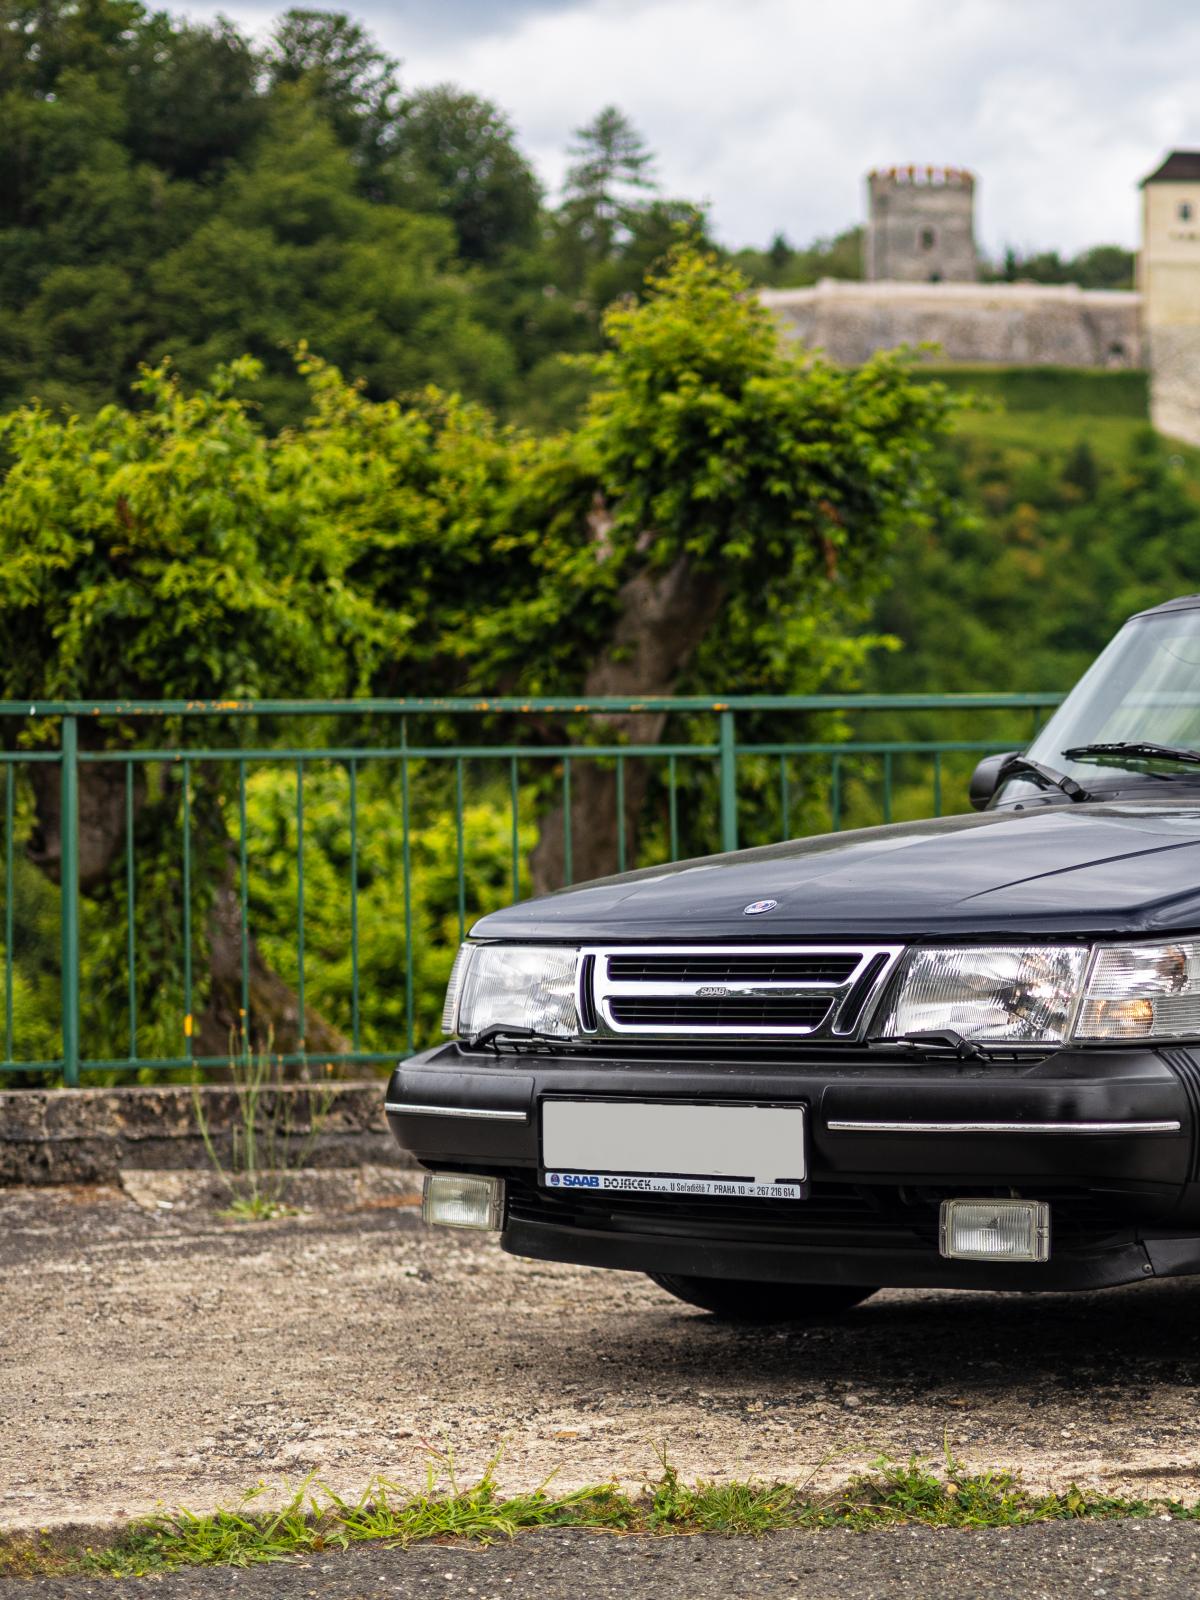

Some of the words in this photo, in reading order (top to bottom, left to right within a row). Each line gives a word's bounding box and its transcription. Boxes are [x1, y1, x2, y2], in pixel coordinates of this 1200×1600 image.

[700, 986, 727, 997] SAAB
[562, 1175, 600, 1187] SAAB
[670, 1182, 675, 1191] U
[706, 1184, 711, 1193] 7
[714, 1185, 736, 1194] PRAHA
[738, 1186, 746, 1195] 10
[757, 1186, 769, 1196] 267
[771, 1187, 782, 1197] 216
[783, 1187, 795, 1197] 614
